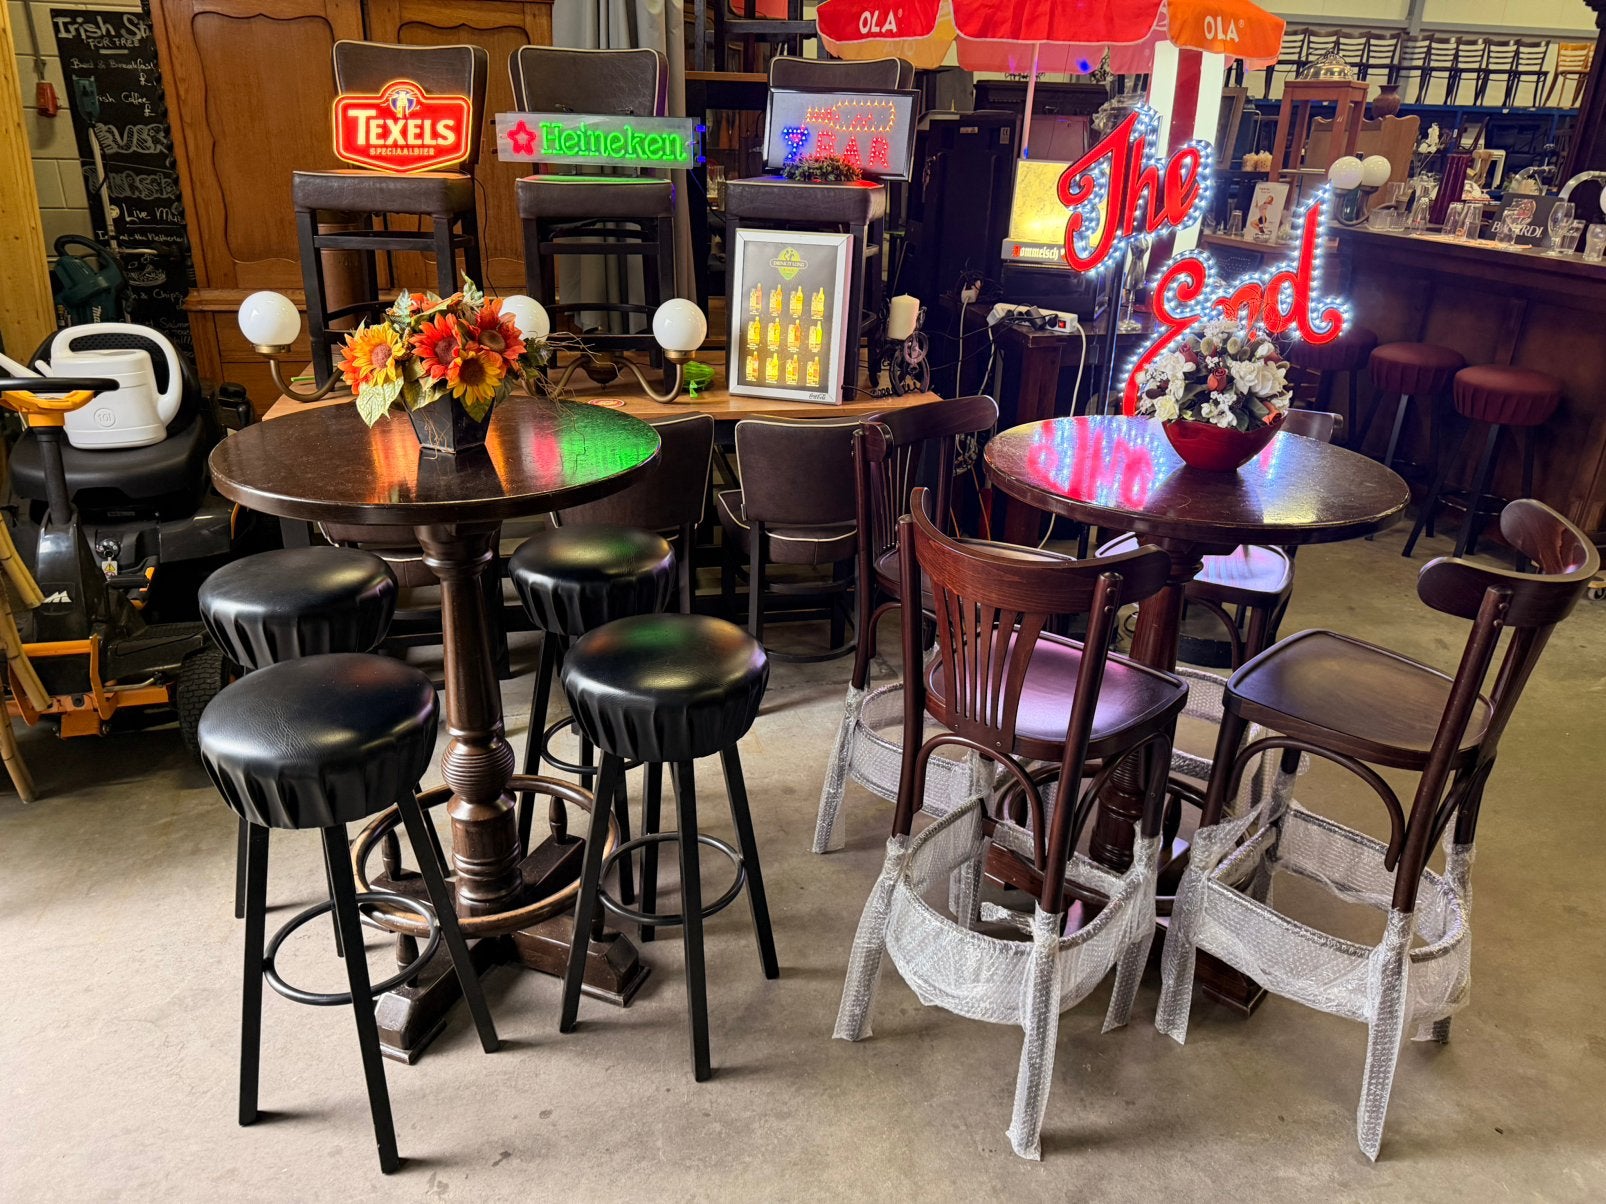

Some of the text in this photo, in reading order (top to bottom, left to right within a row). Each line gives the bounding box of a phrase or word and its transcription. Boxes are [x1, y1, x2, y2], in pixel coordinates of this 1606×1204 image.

[53, 15, 116, 41] Irish
[859, 9, 897, 34] OLA
[1204, 15, 1239, 42] OLA
[86, 37, 140, 49] FOR FREE
[110, 58, 157, 71] Breakfast
[121, 92, 151, 105] Coffee
[369, 147, 435, 156] SPECIAALBIER
[539, 121, 688, 161] Heineken
[816, 130, 889, 169] BAR
[1057, 106, 1206, 272] The
[122, 203, 151, 222] Live
[1012, 244, 1059, 260] Dommelsch
[1122, 198, 1345, 416] End
